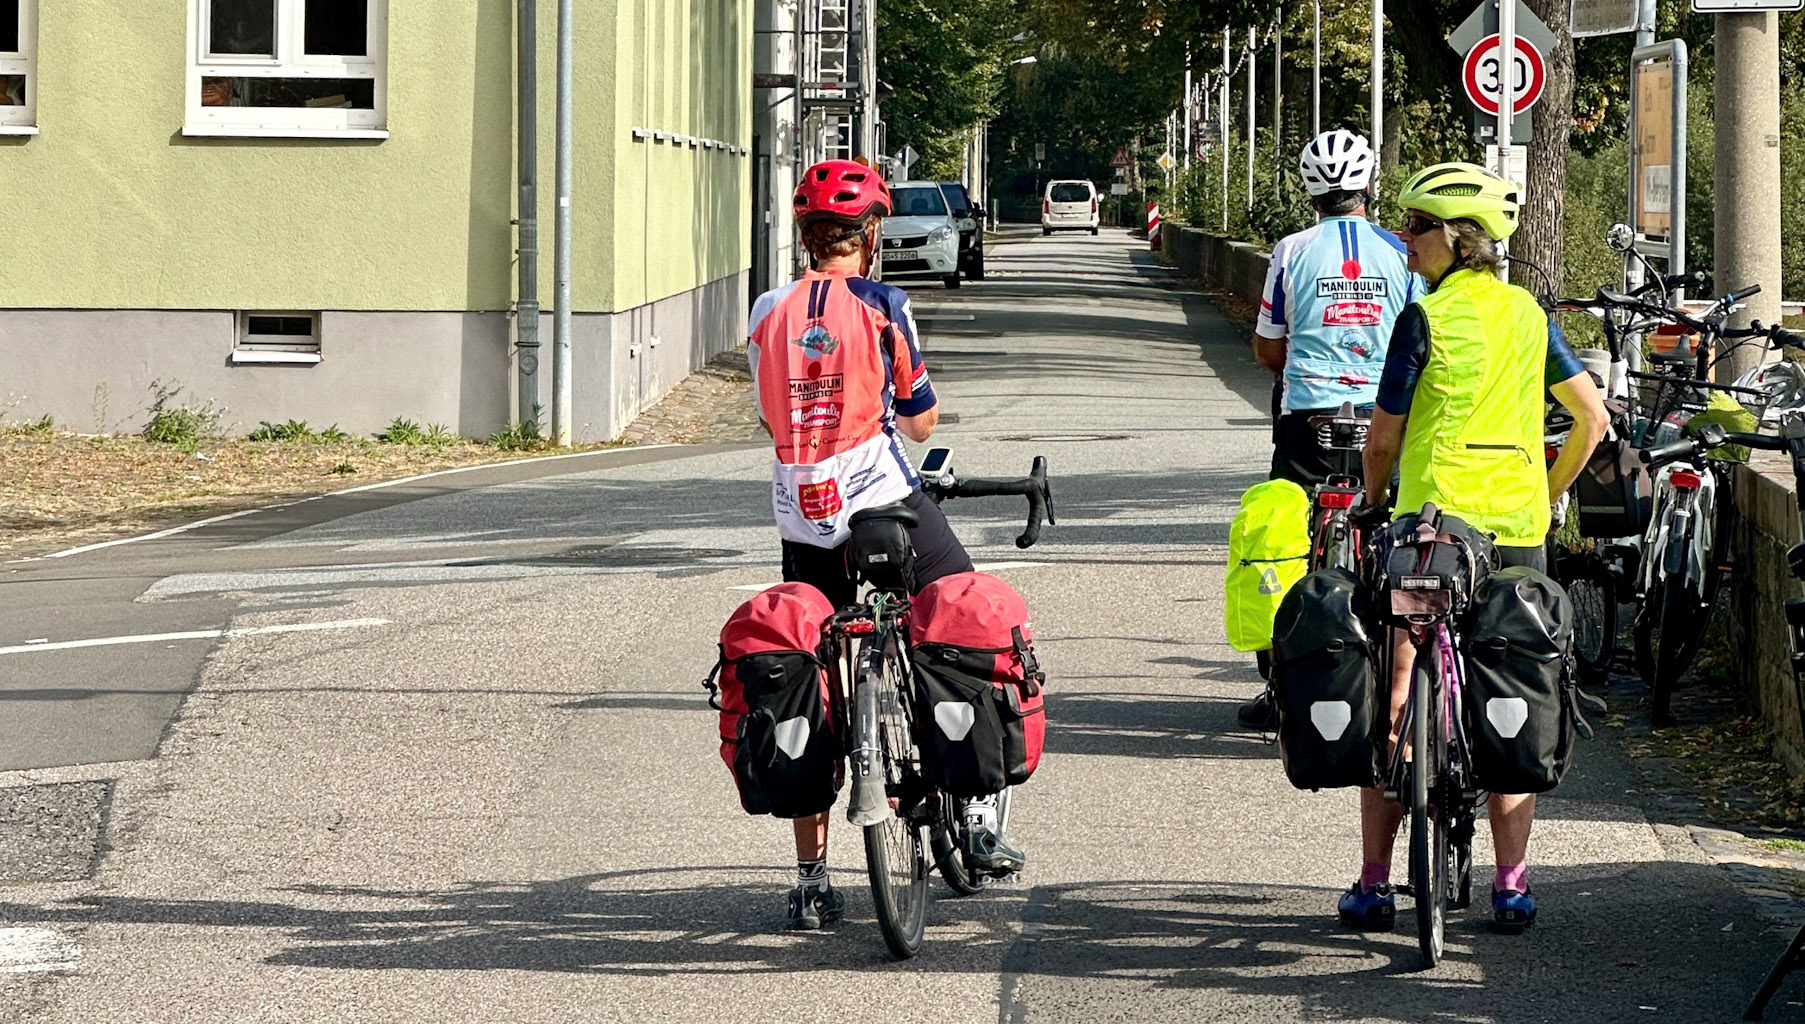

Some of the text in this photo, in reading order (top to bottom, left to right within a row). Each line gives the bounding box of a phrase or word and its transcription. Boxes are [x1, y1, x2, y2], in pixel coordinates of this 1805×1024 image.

[1481, 56, 1527, 93] 30
[1321, 281, 1383, 292] MANITOULIN
[1327, 303, 1380, 321] Manitoulin
[788, 378, 841, 393] MANITOULIN
[791, 403, 841, 426] Manitoulin
